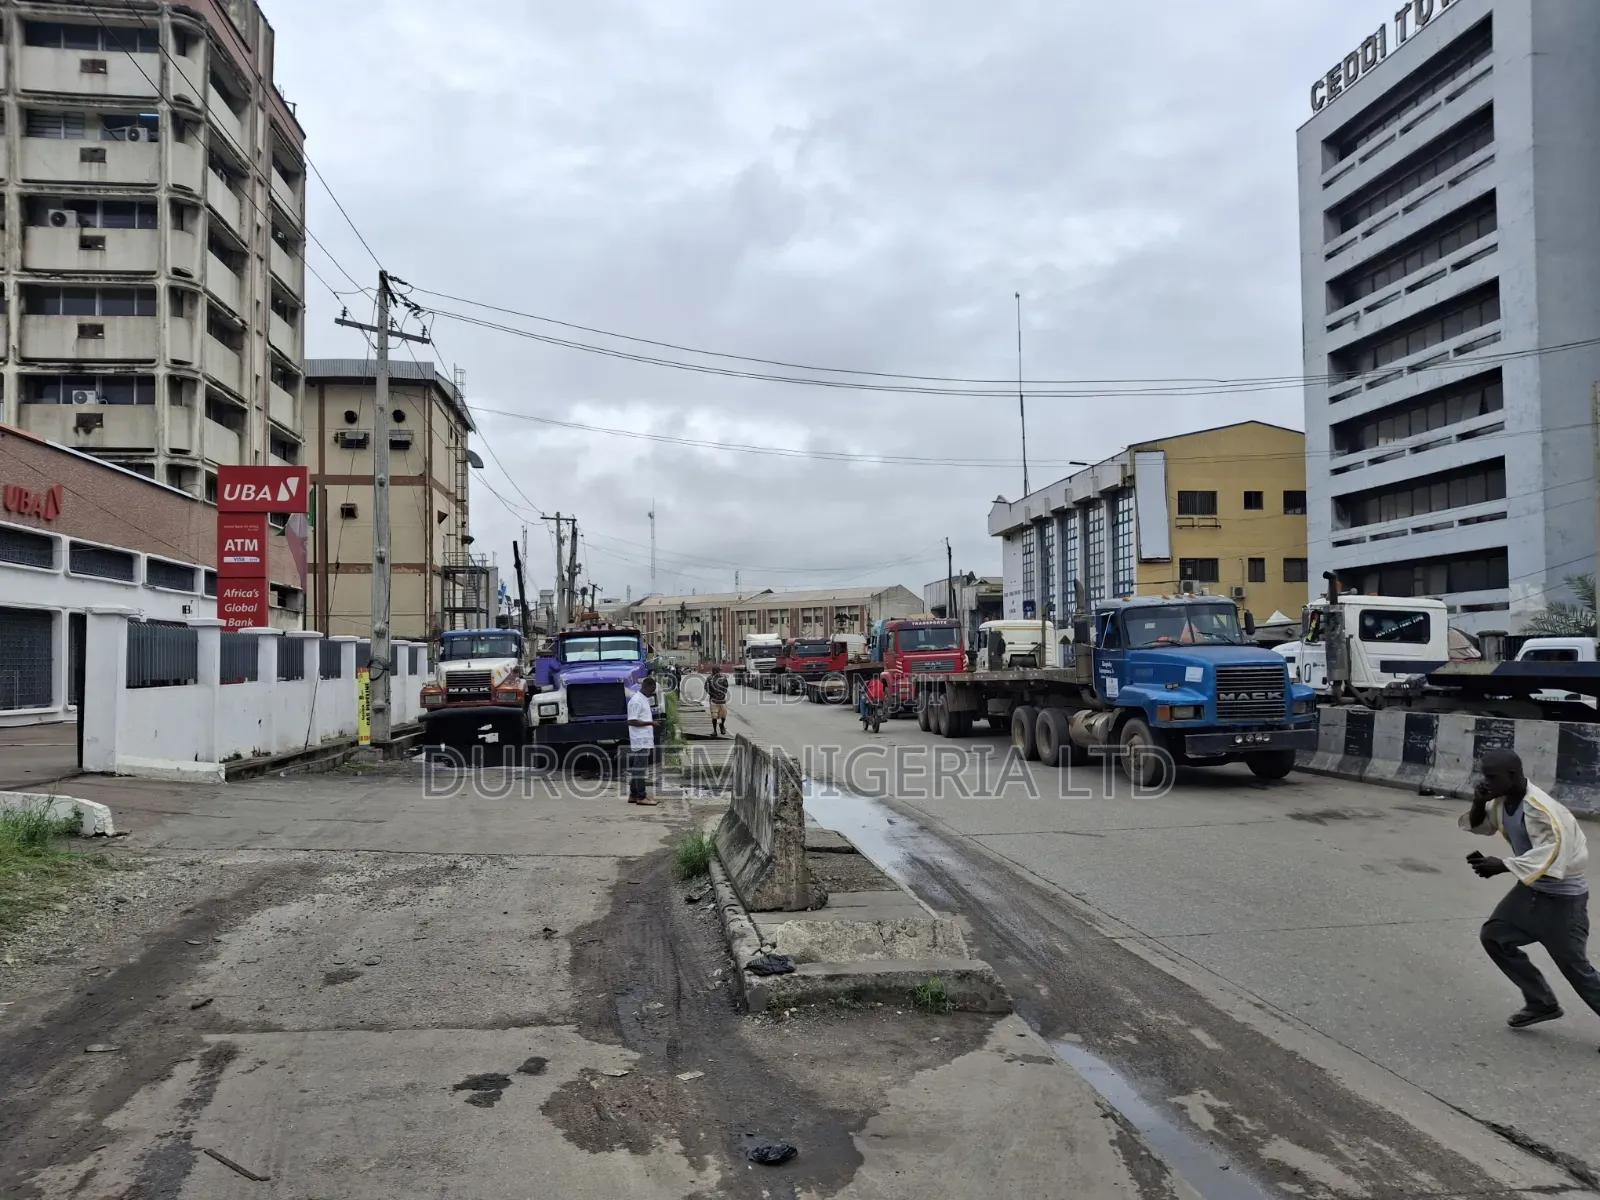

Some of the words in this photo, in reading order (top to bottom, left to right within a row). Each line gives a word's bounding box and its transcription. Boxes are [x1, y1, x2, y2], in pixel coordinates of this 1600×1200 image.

[1310, 23, 1387, 111] CEDDI
[1394, 0, 1457, 43] TO
[223, 483, 272, 502] UBA
[3, 484, 43, 519] UBA
[224, 538, 259, 552] ATM
[224, 603, 258, 613] Global
[227, 618, 254, 627] Bank
[1218, 691, 1283, 702] MACK
